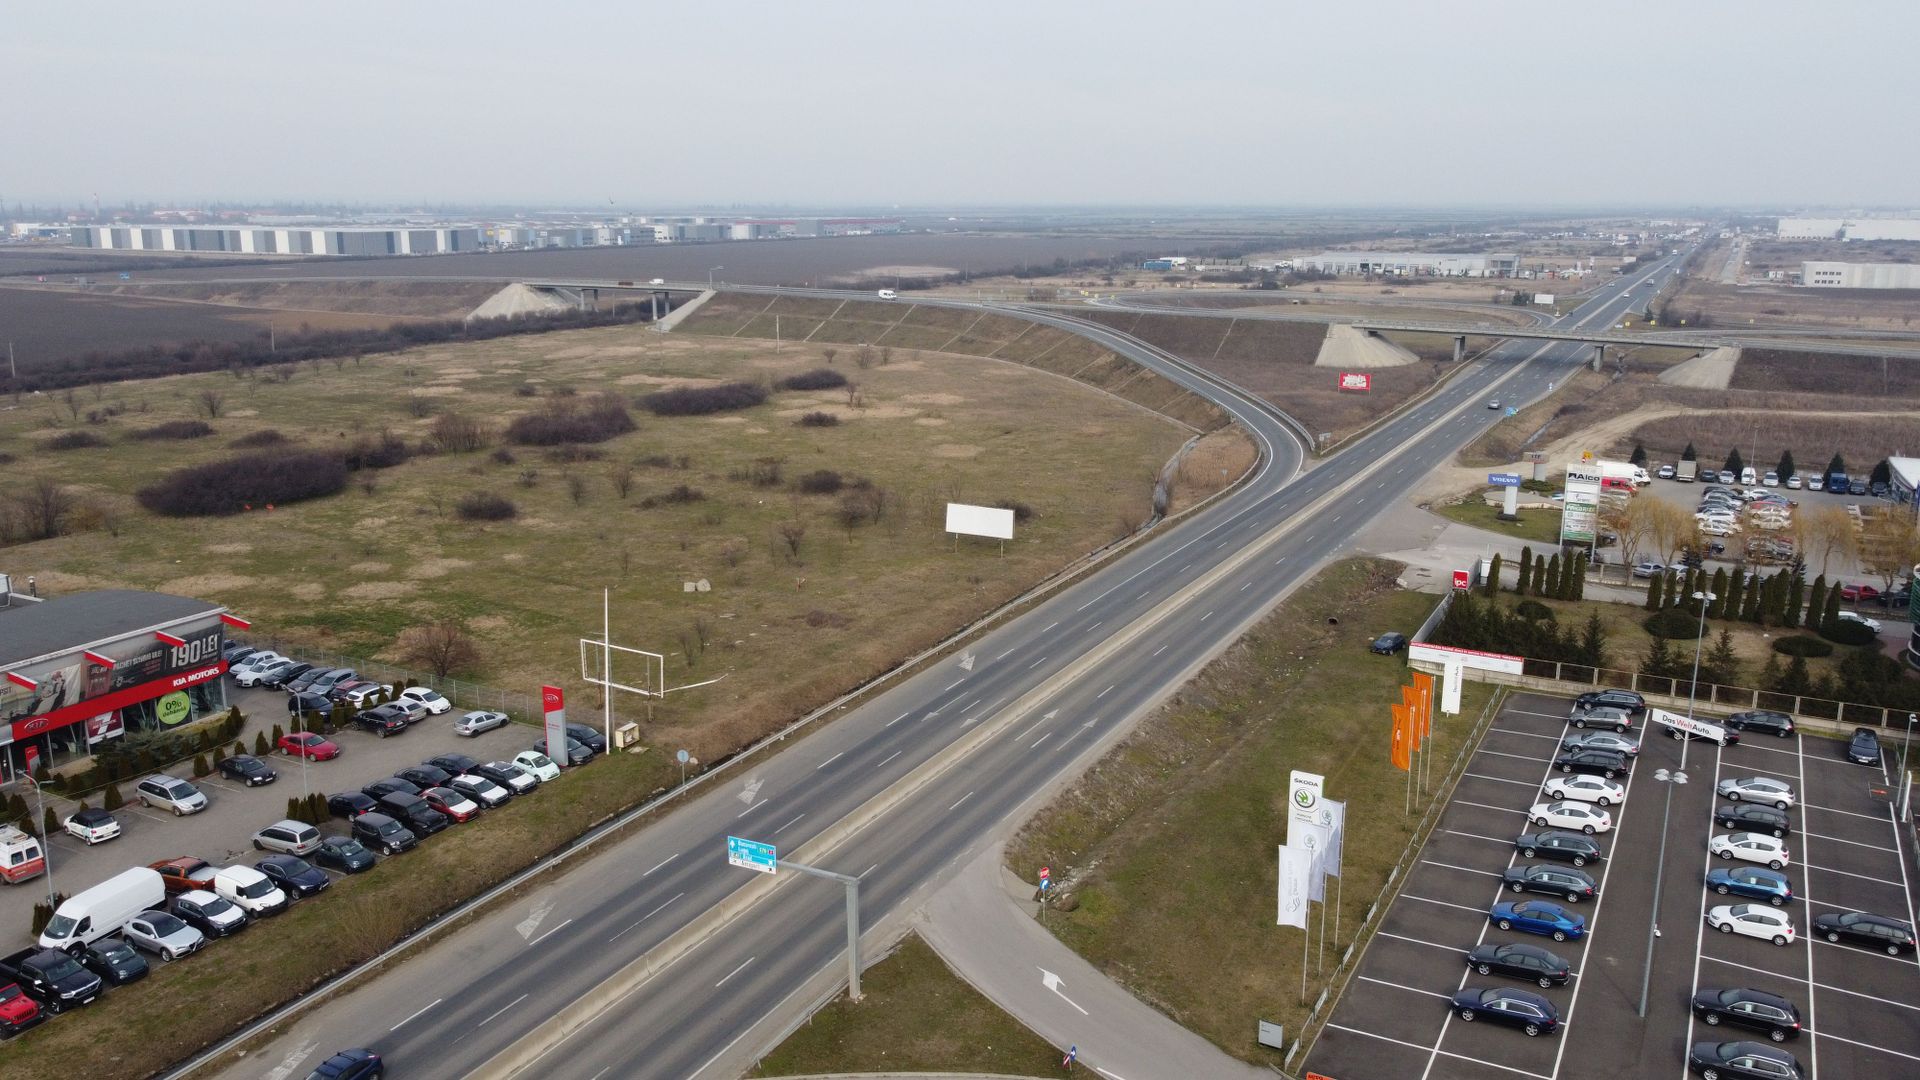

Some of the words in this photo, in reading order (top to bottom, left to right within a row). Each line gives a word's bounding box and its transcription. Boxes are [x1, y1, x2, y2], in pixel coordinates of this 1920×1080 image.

[171, 639, 201, 668] 190
[202, 634, 218, 655] LEI
[173, 677, 187, 687] KIA
[188, 667, 220, 682] MOTORS
[1662, 714, 1676, 724] Das
